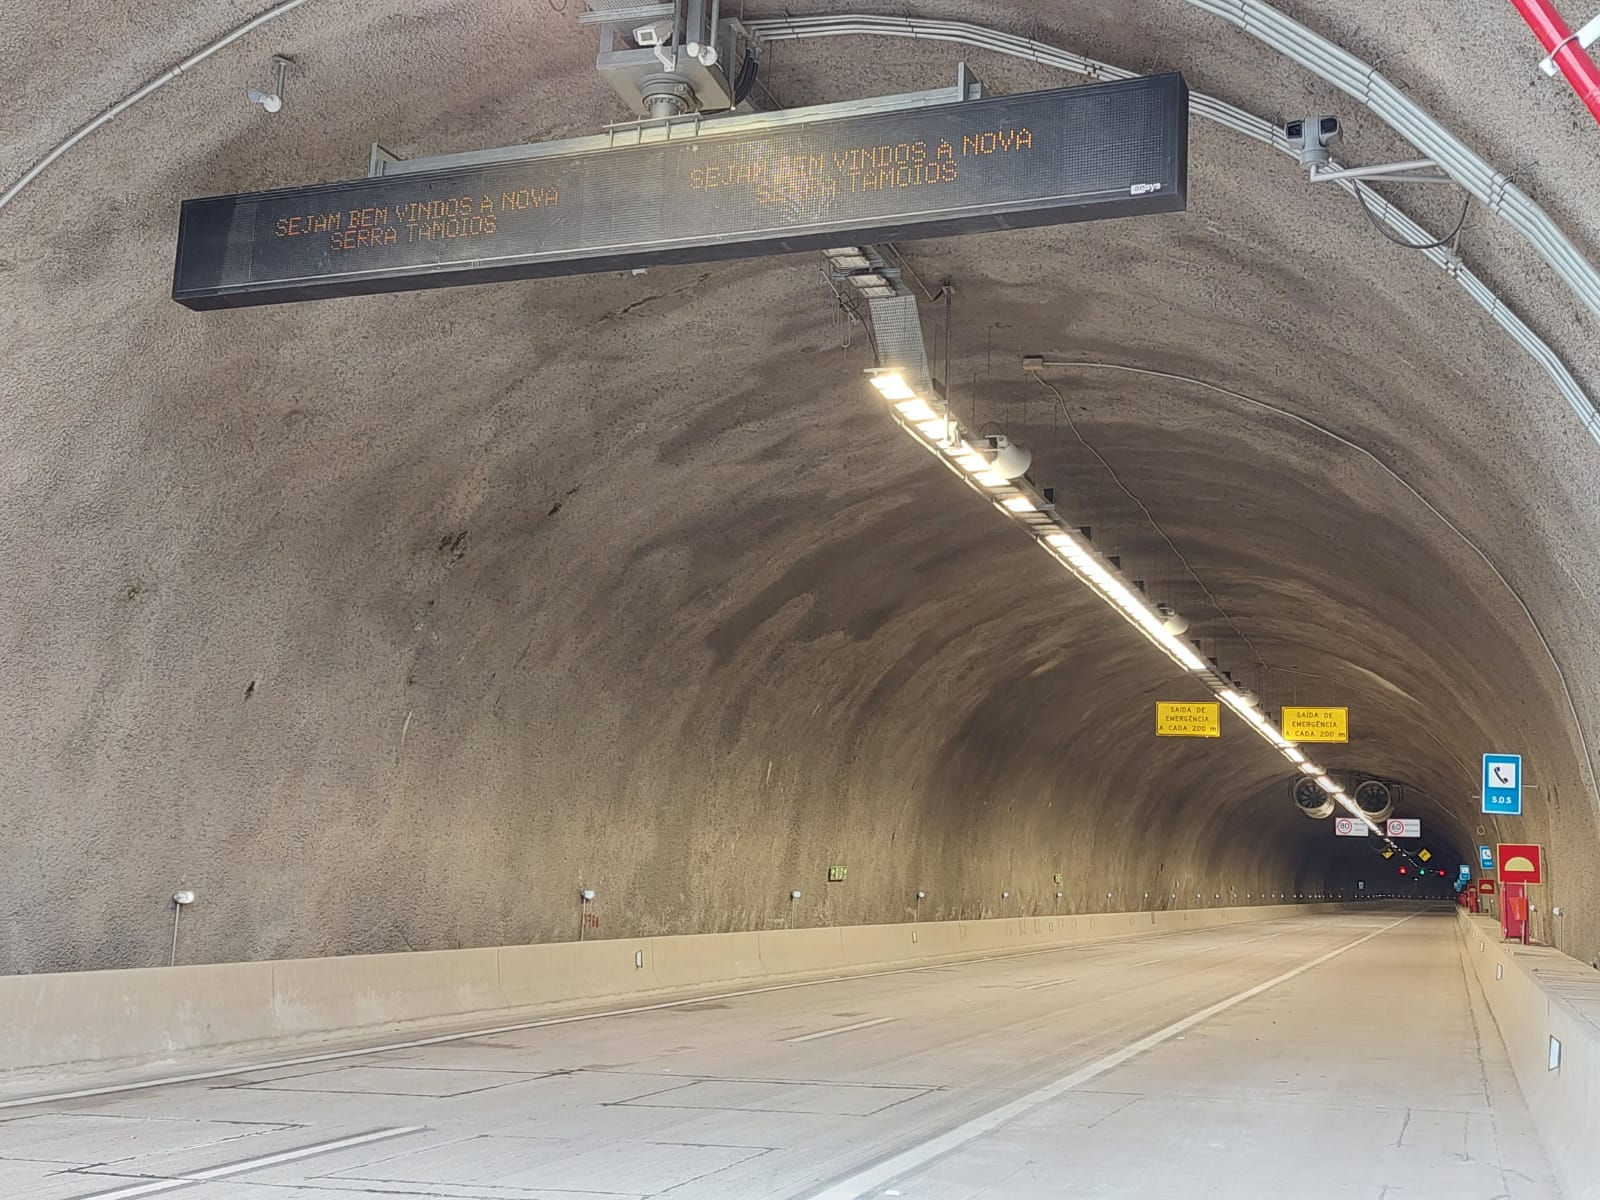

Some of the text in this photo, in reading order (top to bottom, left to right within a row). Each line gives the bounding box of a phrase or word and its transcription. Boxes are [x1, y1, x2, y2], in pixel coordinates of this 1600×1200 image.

[689, 161, 767, 190] SEJAM
[833, 141, 927, 172] VINDOS
[963, 127, 1034, 157] NOVA
[846, 160, 958, 193] TAMOIOS
[275, 211, 341, 237] SEJAM
[348, 206, 388, 229] BEM
[395, 195, 473, 223] VINDOS
[501, 186, 559, 211] NOVA
[330, 214, 497, 250] SERRA TAMOIOS
[1169, 705, 1207, 714] SAÍDA DE
[1165, 714, 1210, 723] EMERGÊNCIA
[1296, 711, 1319, 719] SAÍDA
[1291, 720, 1338, 729] EMERGÊNCIA
[1339, 822, 1350, 830] 80
[1391, 823, 1402, 831] 60
